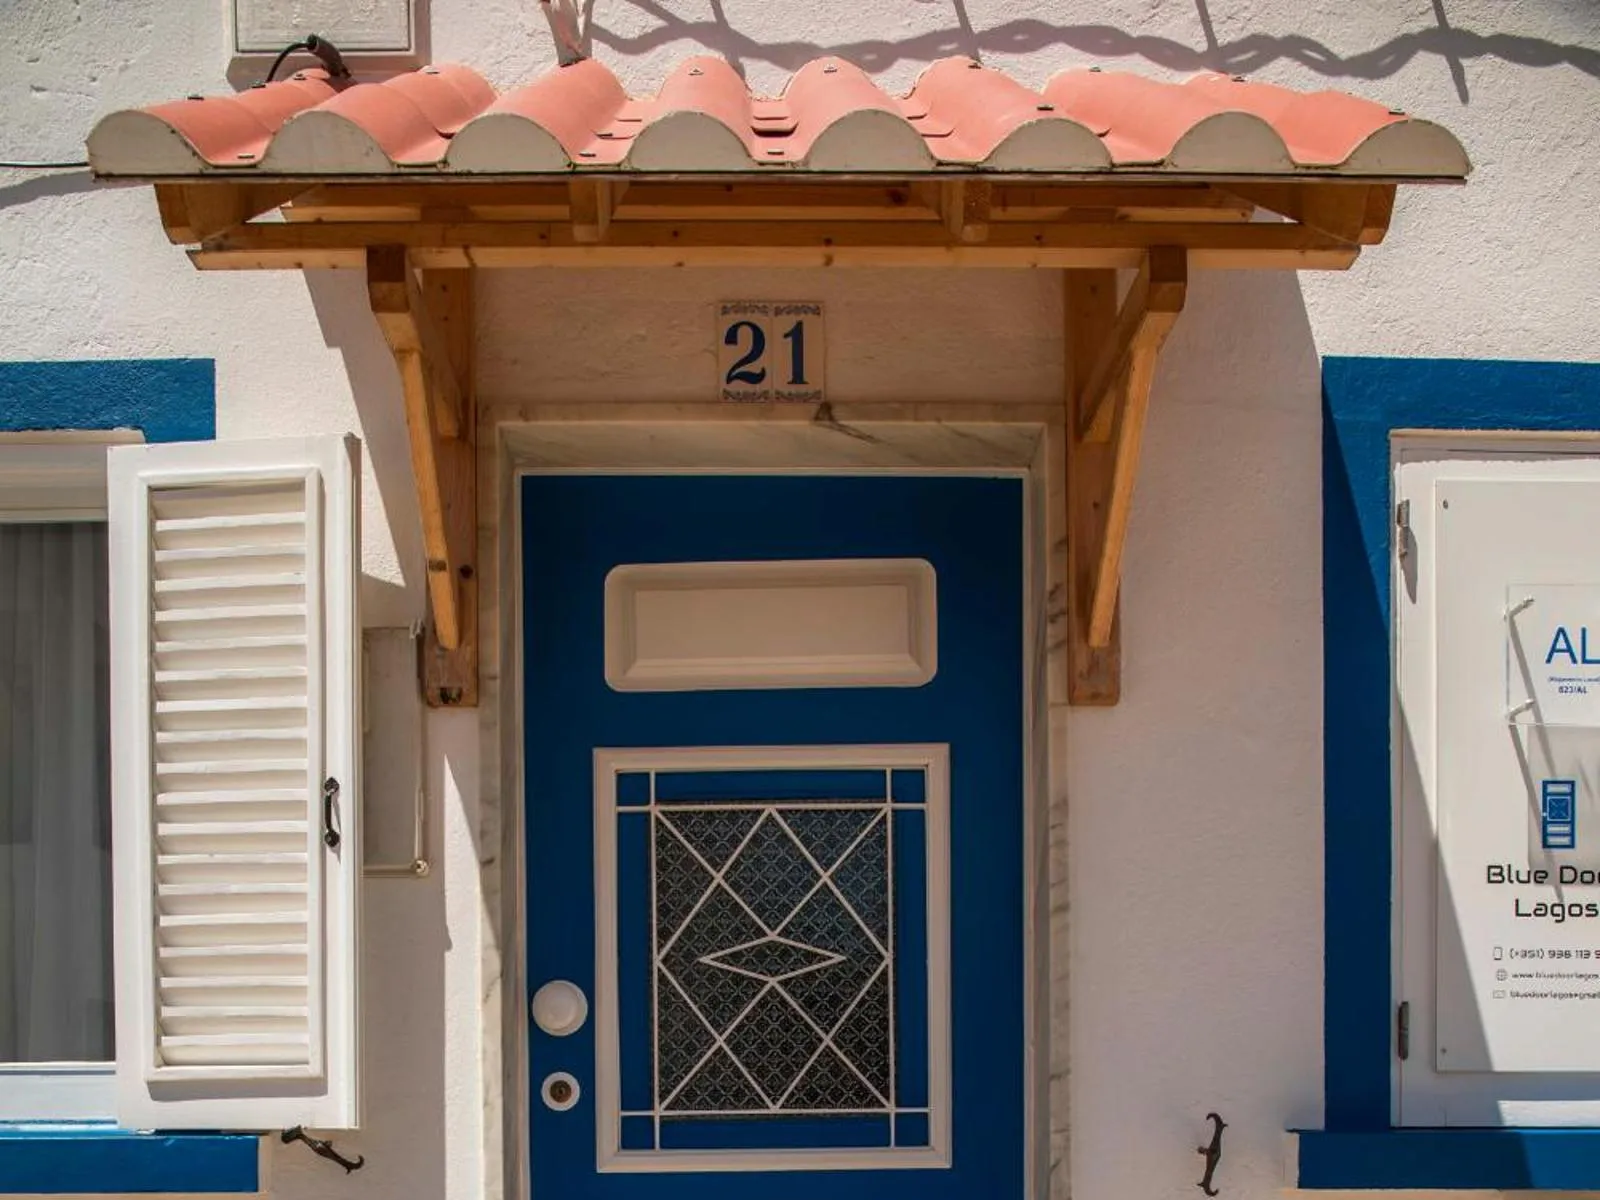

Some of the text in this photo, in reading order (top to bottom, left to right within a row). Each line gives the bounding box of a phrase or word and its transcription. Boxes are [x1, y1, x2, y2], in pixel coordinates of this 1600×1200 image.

[724, 320, 810, 385] 21
[1545, 626, 1600, 665] AL
[1487, 864, 1600, 885] Blue Do
[1515, 898, 1600, 923] Lagos
